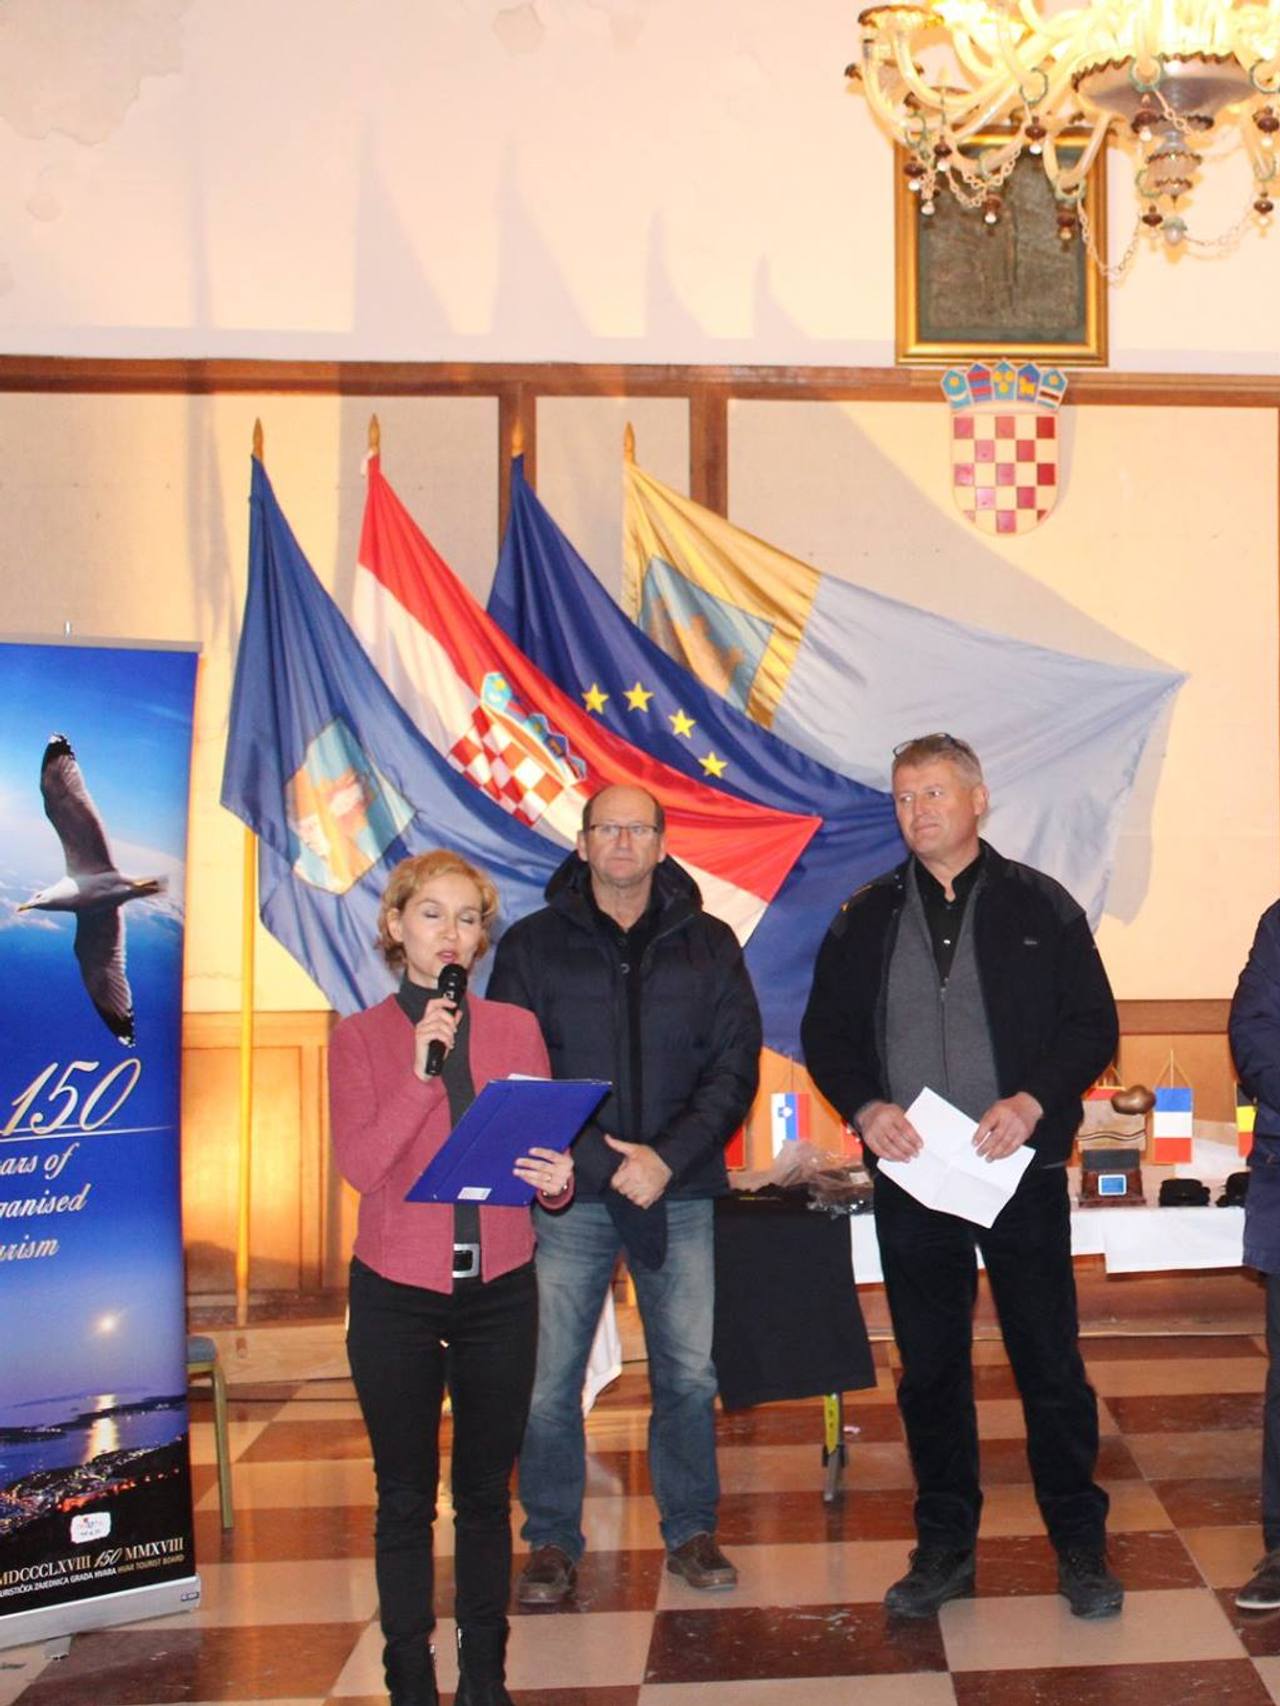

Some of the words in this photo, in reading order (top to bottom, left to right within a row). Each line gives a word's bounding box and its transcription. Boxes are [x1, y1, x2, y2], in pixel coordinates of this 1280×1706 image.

[1, 1058, 141, 1136] 150
[0, 1155, 38, 1176] ars
[44, 1142, 80, 1180] of
[93, 1546, 123, 1569] 150
[124, 1537, 184, 1561] MMXVIII
